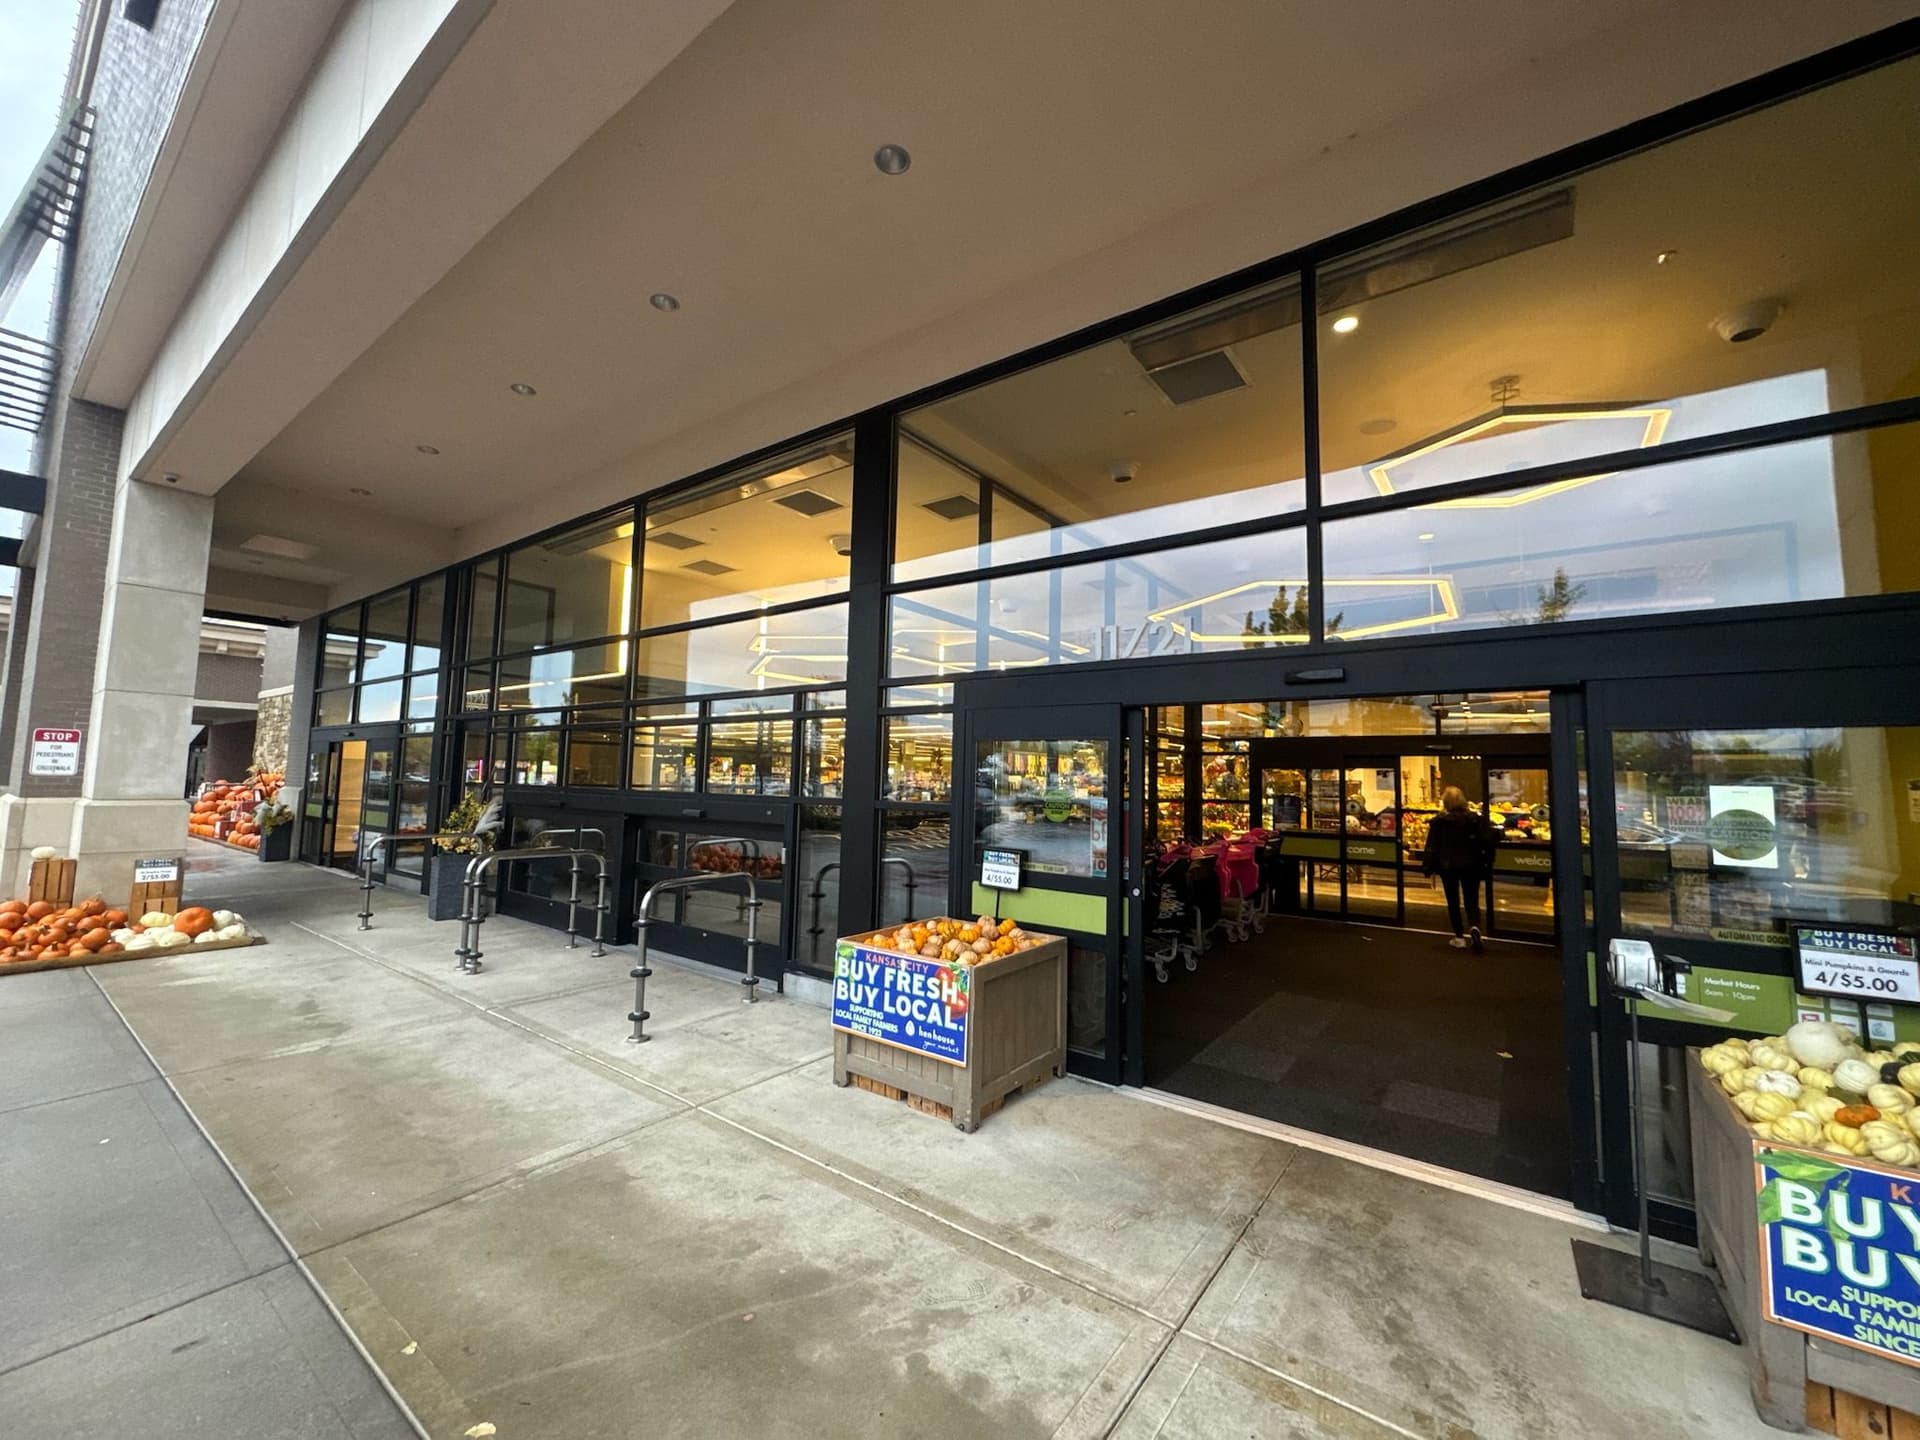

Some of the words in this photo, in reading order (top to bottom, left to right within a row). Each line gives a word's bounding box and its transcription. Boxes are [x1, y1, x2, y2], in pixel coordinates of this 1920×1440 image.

[1090, 616, 1192, 660] 11721
[42, 732, 73, 741] STOP
[1347, 846, 1376, 855] come
[1514, 855, 1551, 867] welco
[1718, 930, 1765, 943] AUTOMATIC
[1814, 930, 1844, 938] BUY
[1848, 932, 1897, 944] FRESH
[1815, 938, 1845, 949] BUY
[1849, 943, 1897, 954] LOCAL
[865, 952, 901, 969] KANSAS
[905, 960, 929, 974] CITY
[1825, 961, 1865, 972] Pumpkins
[1877, 967, 1910, 977] Gourds
[838, 957, 880, 985] BUY
[884, 966, 958, 1004] FRESH
[1704, 977, 1733, 988] Market
[1735, 981, 1760, 991] Hours
[1815, 971, 1899, 993] 4/$5.00
[1704, 989, 1724, 997] 6am
[1733, 991, 1756, 1001] 10pm
[836, 978, 880, 1009] BUY
[883, 990, 964, 1032] LOCAL.
[849, 1003, 884, 1020] SUPPORTING
[835, 1008, 852, 1020] LOCAL
[853, 1013, 872, 1026] FAMILY
[873, 1019, 898, 1034] FARMERS
[851, 1022, 868, 1033] SINCE
[919, 1025, 932, 1039] hen
[933, 1029, 955, 1045] house
[1785, 1286, 1855, 1320] LOCAL
[1841, 1285, 1920, 1320] SUPPO
[1854, 1324, 1920, 1357] SINCE
